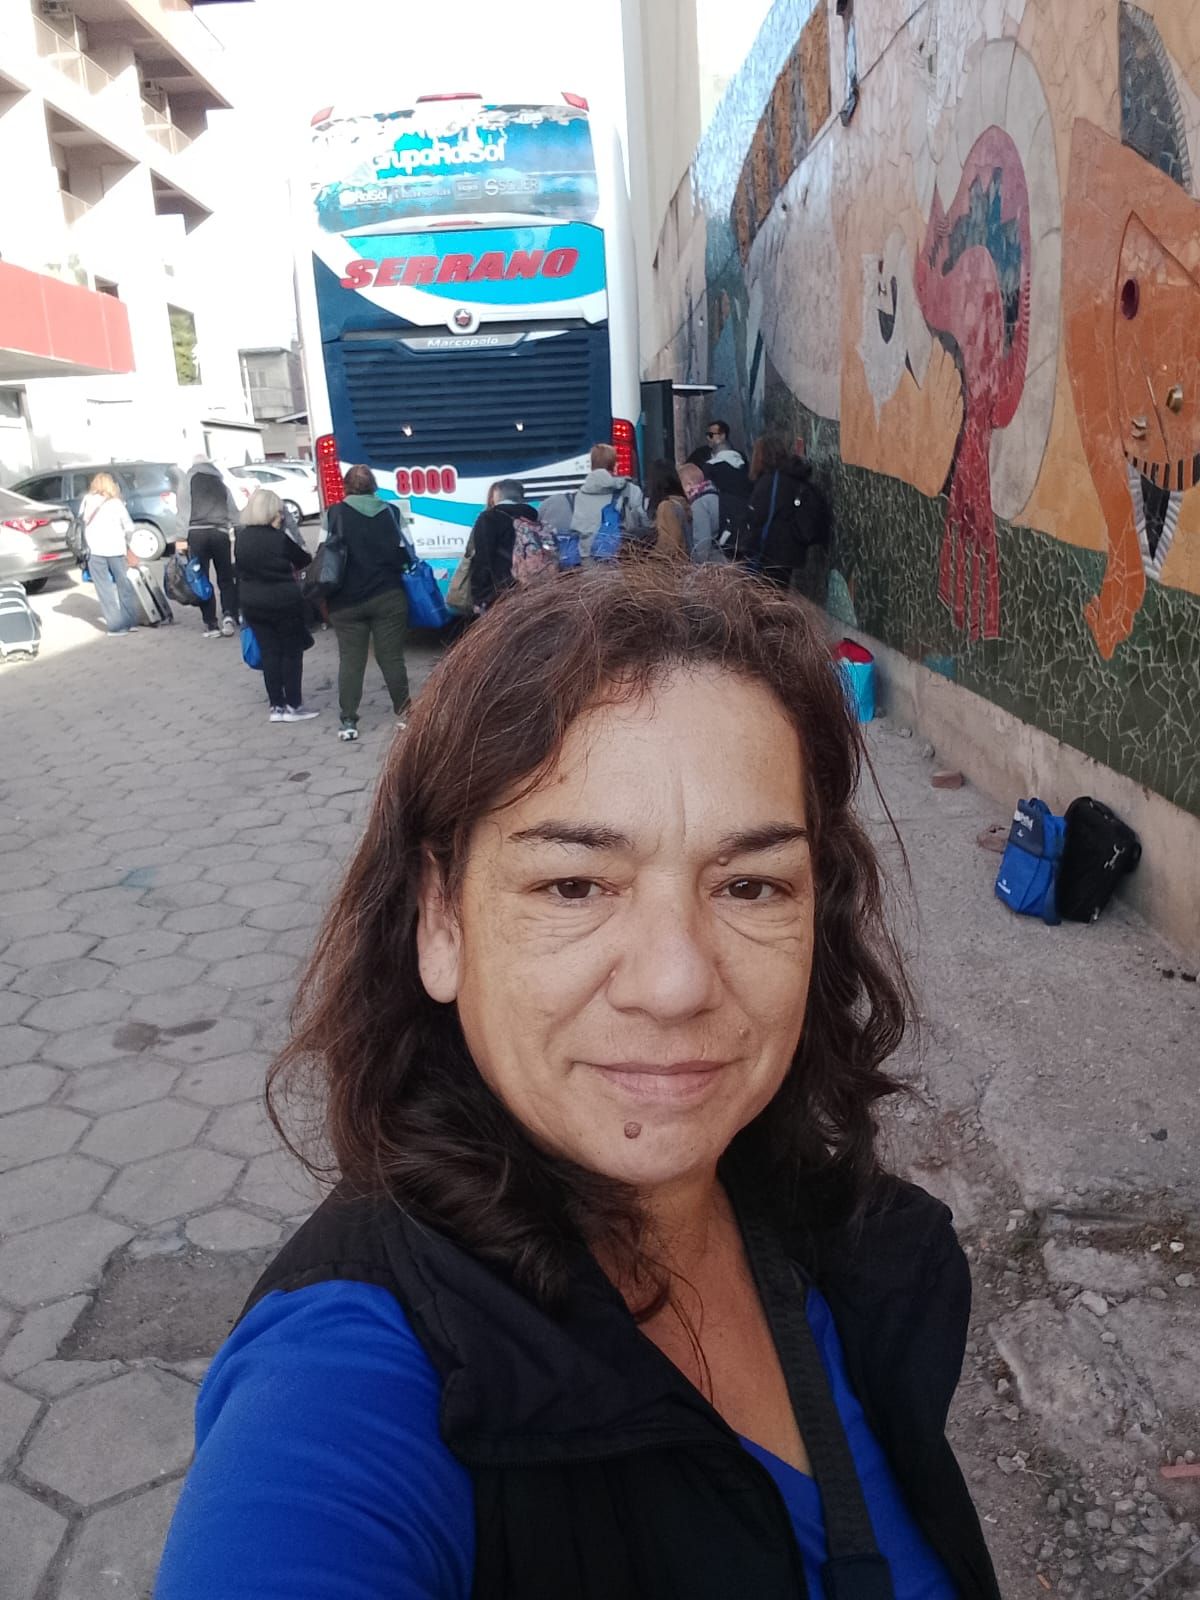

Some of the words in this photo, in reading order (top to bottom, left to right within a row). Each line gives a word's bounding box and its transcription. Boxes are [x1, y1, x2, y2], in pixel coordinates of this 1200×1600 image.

[340, 247, 579, 289] SERRANO
[427, 336, 499, 347] Marcopolo
[395, 467, 457, 495] 8000
[416, 536, 465, 547] salim
